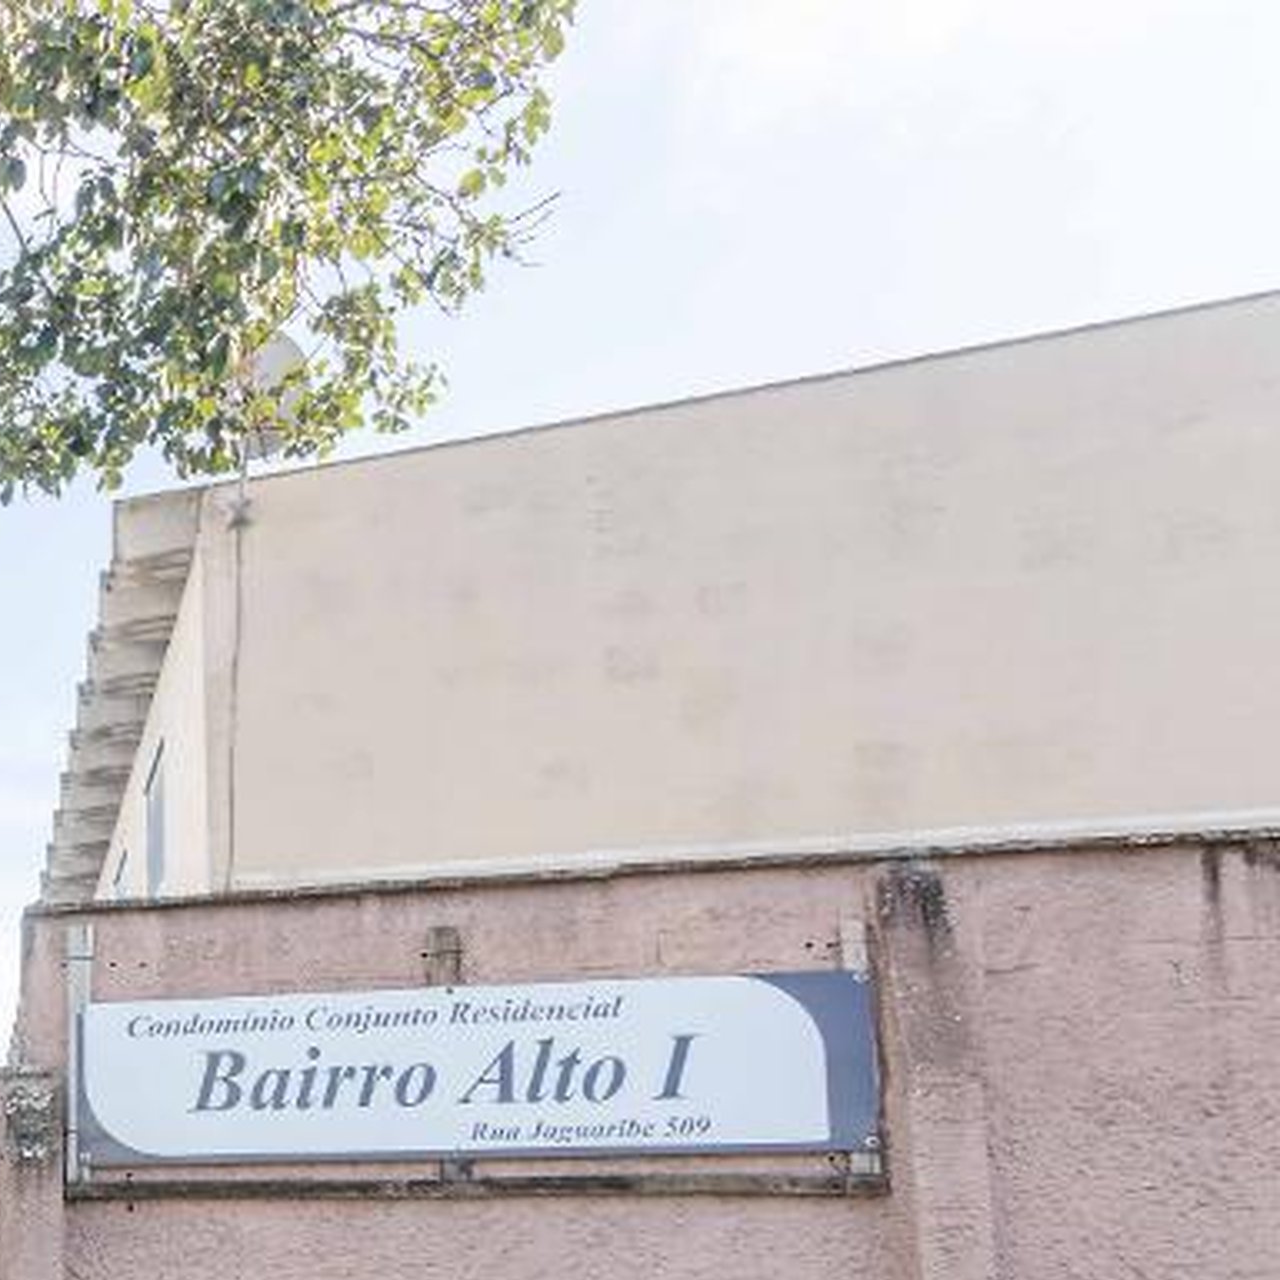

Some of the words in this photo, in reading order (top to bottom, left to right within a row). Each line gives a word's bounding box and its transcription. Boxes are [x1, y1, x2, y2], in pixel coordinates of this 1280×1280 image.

[306, 1004, 438, 1035] Conjunto
[449, 996, 622, 1025] Residencial
[187, 1045, 437, 1114] Bairro
[457, 1036, 627, 1104] Alto
[652, 1032, 702, 1101] I
[471, 1122, 521, 1142] Rua
[532, 1119, 655, 1144] Jaguaribe
[664, 1116, 712, 1138] 509
